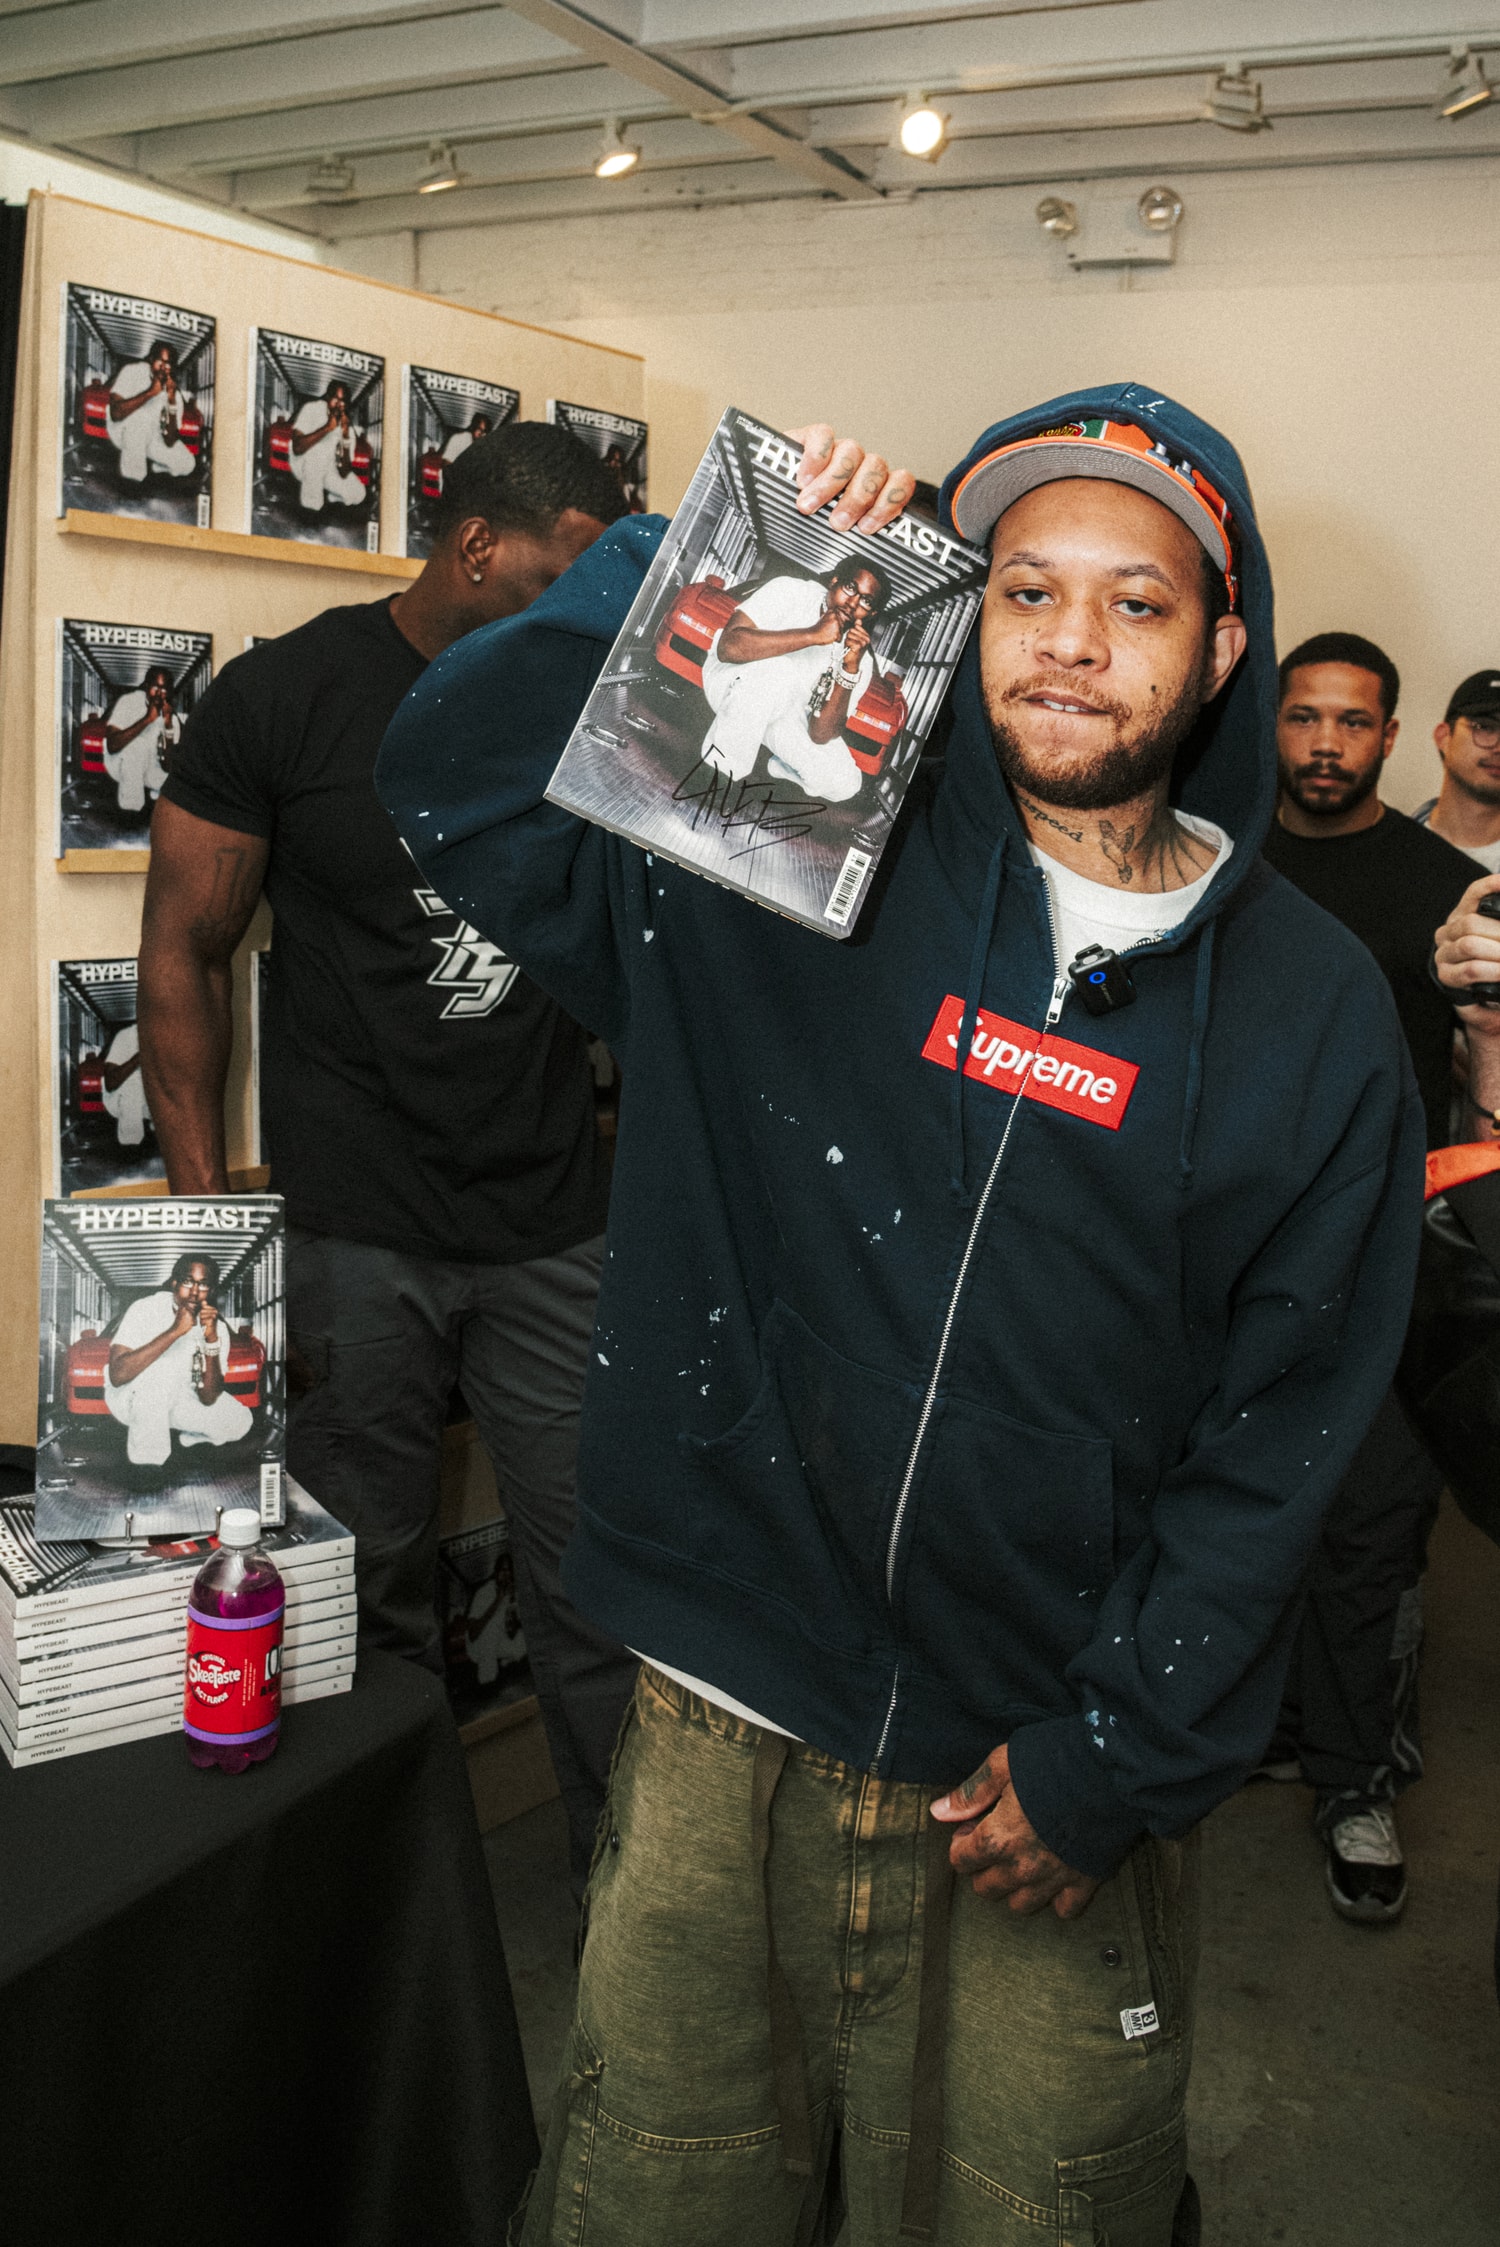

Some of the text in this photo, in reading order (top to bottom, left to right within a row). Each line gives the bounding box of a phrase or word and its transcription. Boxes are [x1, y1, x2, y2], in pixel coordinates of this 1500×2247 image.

[89, 291, 201, 333] HYPEBEAST
[275, 336, 373, 372] HYPEBEAST
[425, 373, 511, 405] HYPEBEAST
[568, 407, 641, 437] HYPEBEAST
[753, 438, 961, 566] HYAST
[85, 625, 197, 652] HYPEBEAST
[79, 1206, 256, 1231] HYPEBEAST
[34, 1597, 69, 1608] HYPEBEAST
[31, 1617, 66, 1628] HYPEBEAST
[34, 1639, 69, 1650] HYPEBEAST
[38, 1662, 73, 1674] HYPEBEAST
[37, 1683, 72, 1695] HYPEBEAST
[36, 1707, 71, 1718] HYPEBEAST
[34, 1727, 69, 1739] HYPEBEAST
[31, 1746, 66, 1758] HYPEBEAST
